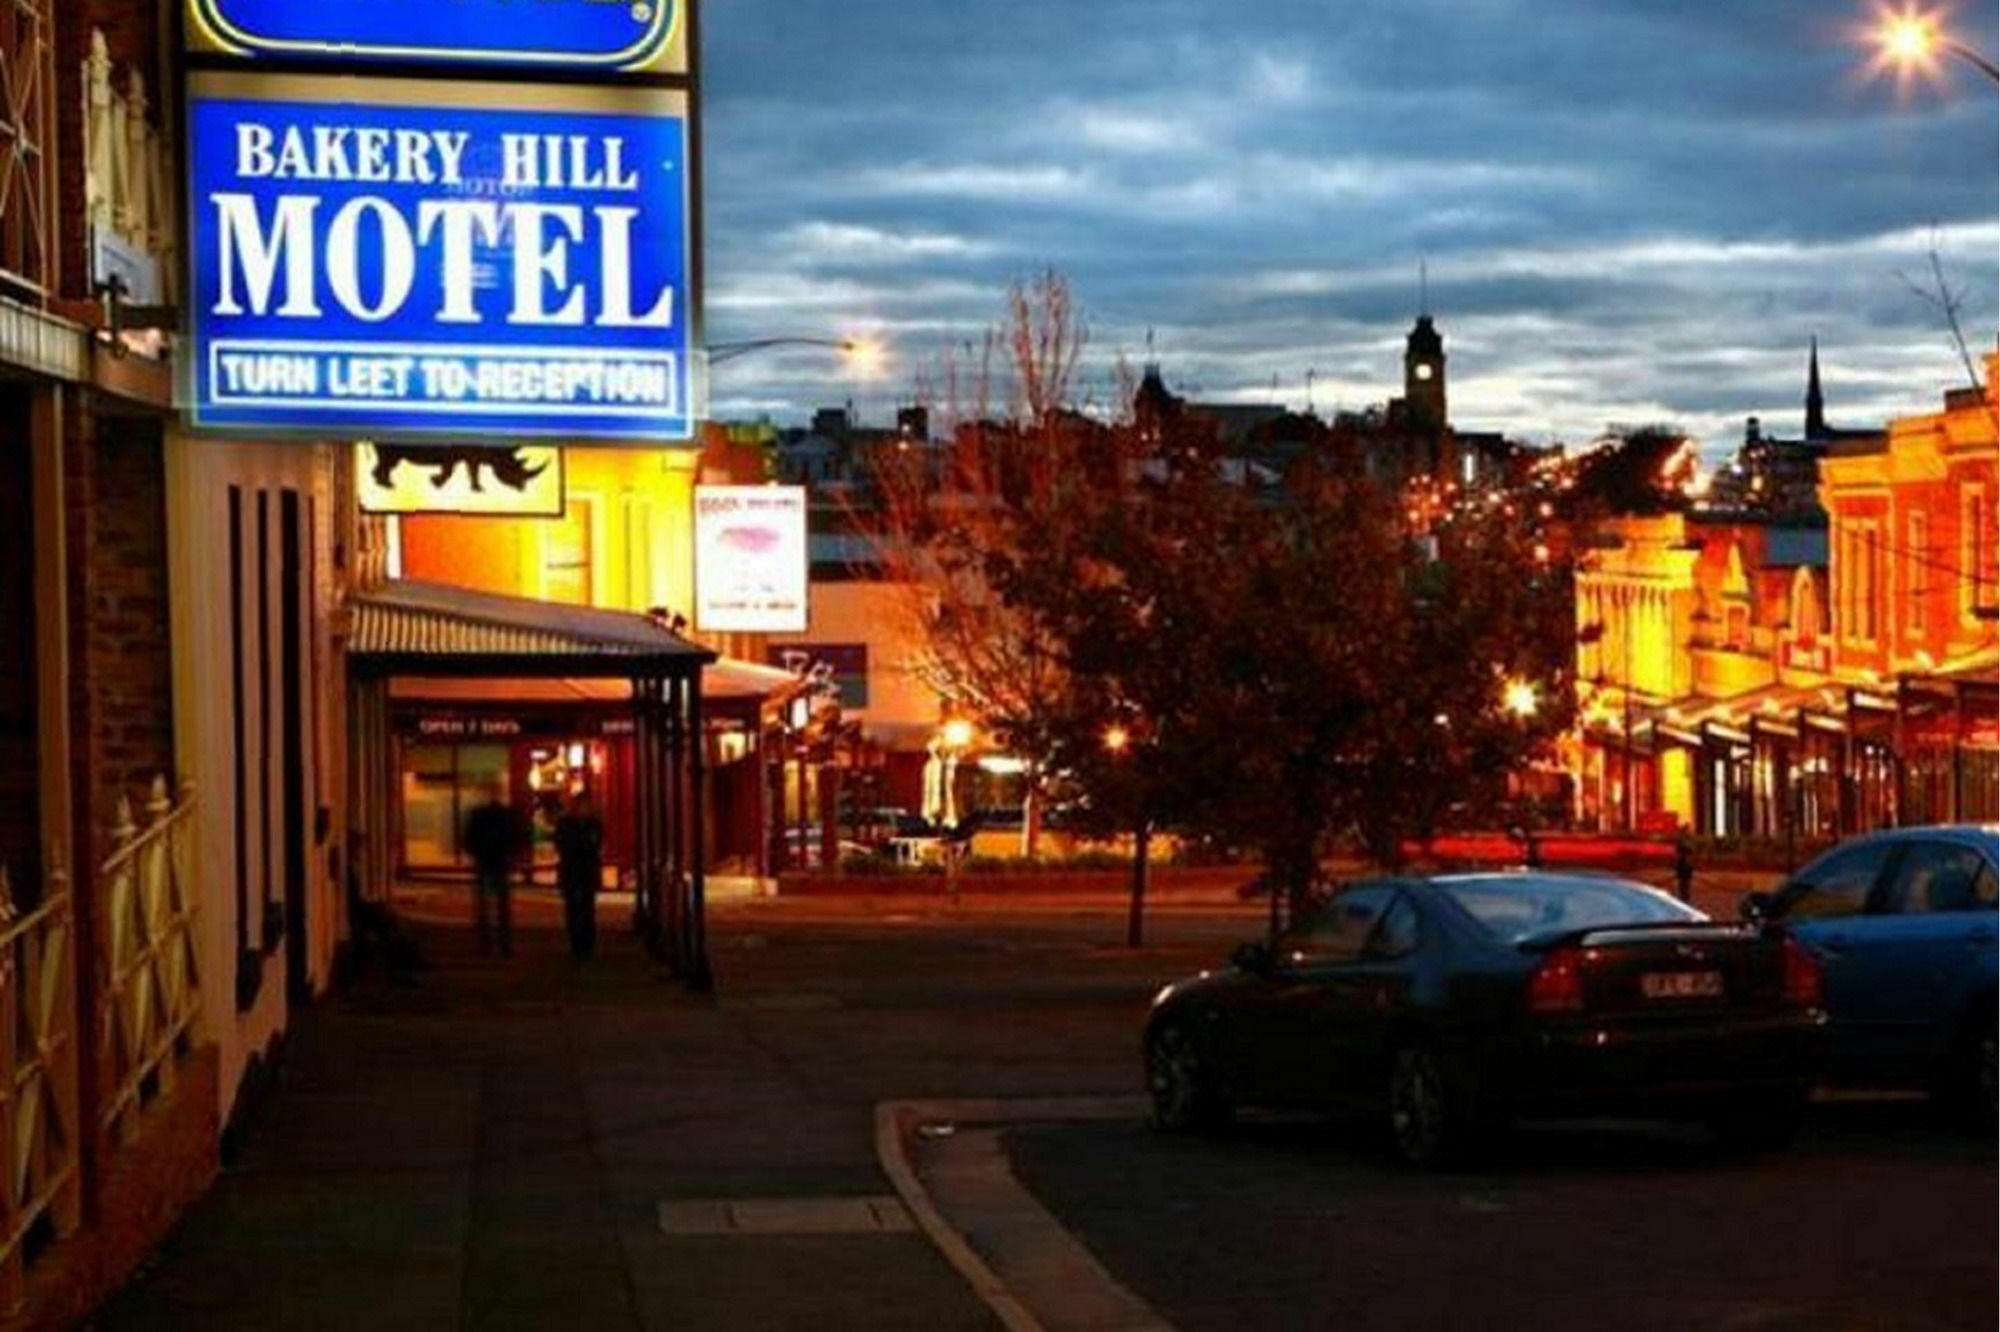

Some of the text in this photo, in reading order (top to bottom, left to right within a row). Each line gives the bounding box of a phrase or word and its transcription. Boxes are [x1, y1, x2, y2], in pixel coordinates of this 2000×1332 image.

[235, 123, 638, 190] BAKERY HILL
[210, 193, 673, 327] MOTEL
[221, 355, 317, 394] TURN
[477, 361, 667, 403] RECEPTION
